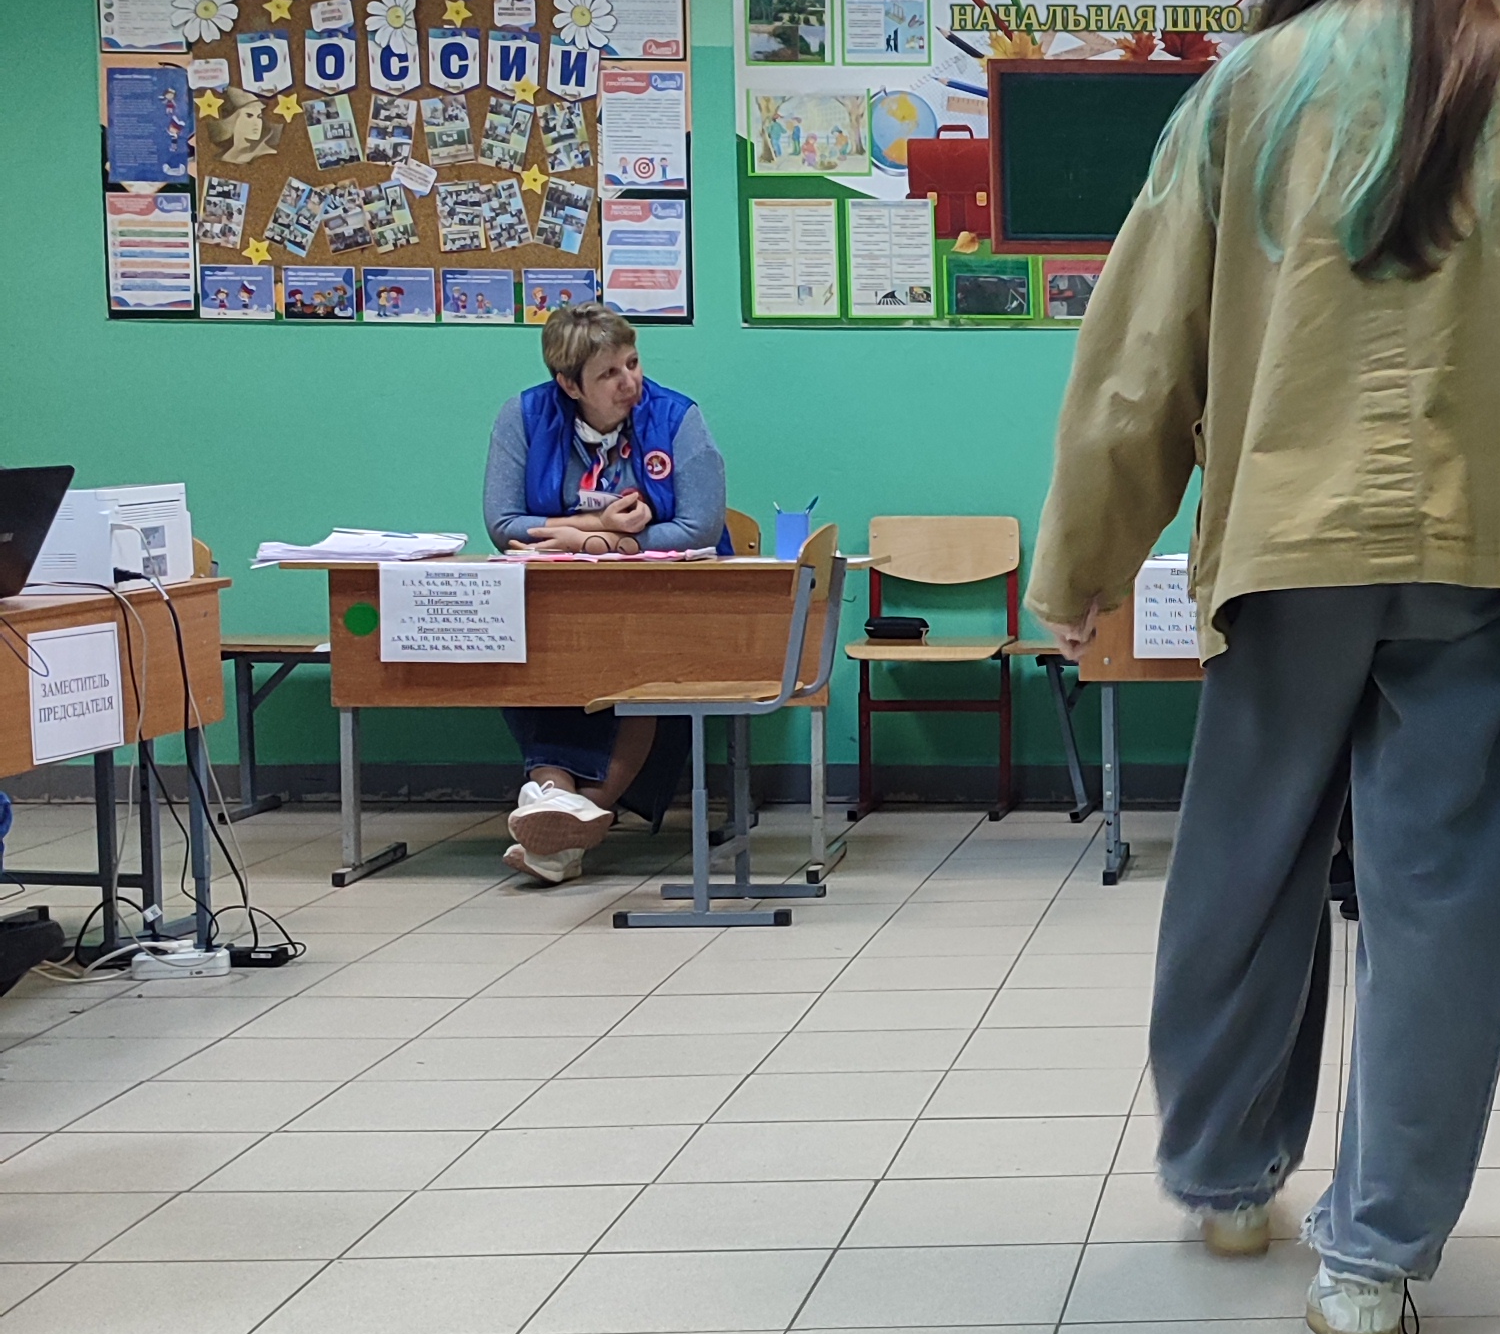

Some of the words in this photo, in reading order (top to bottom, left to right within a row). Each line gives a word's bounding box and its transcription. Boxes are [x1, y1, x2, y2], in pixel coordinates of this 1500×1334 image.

[950, 4, 1156, 32] НАЧАЛЬНАЯ
[250, 39, 588, 86] РОССИИ
[41, 673, 110, 698] ЗАМЕСТИТЕЛЬ
[39, 696, 114, 723] ПРЕДСЕДАТЕЛЯ
